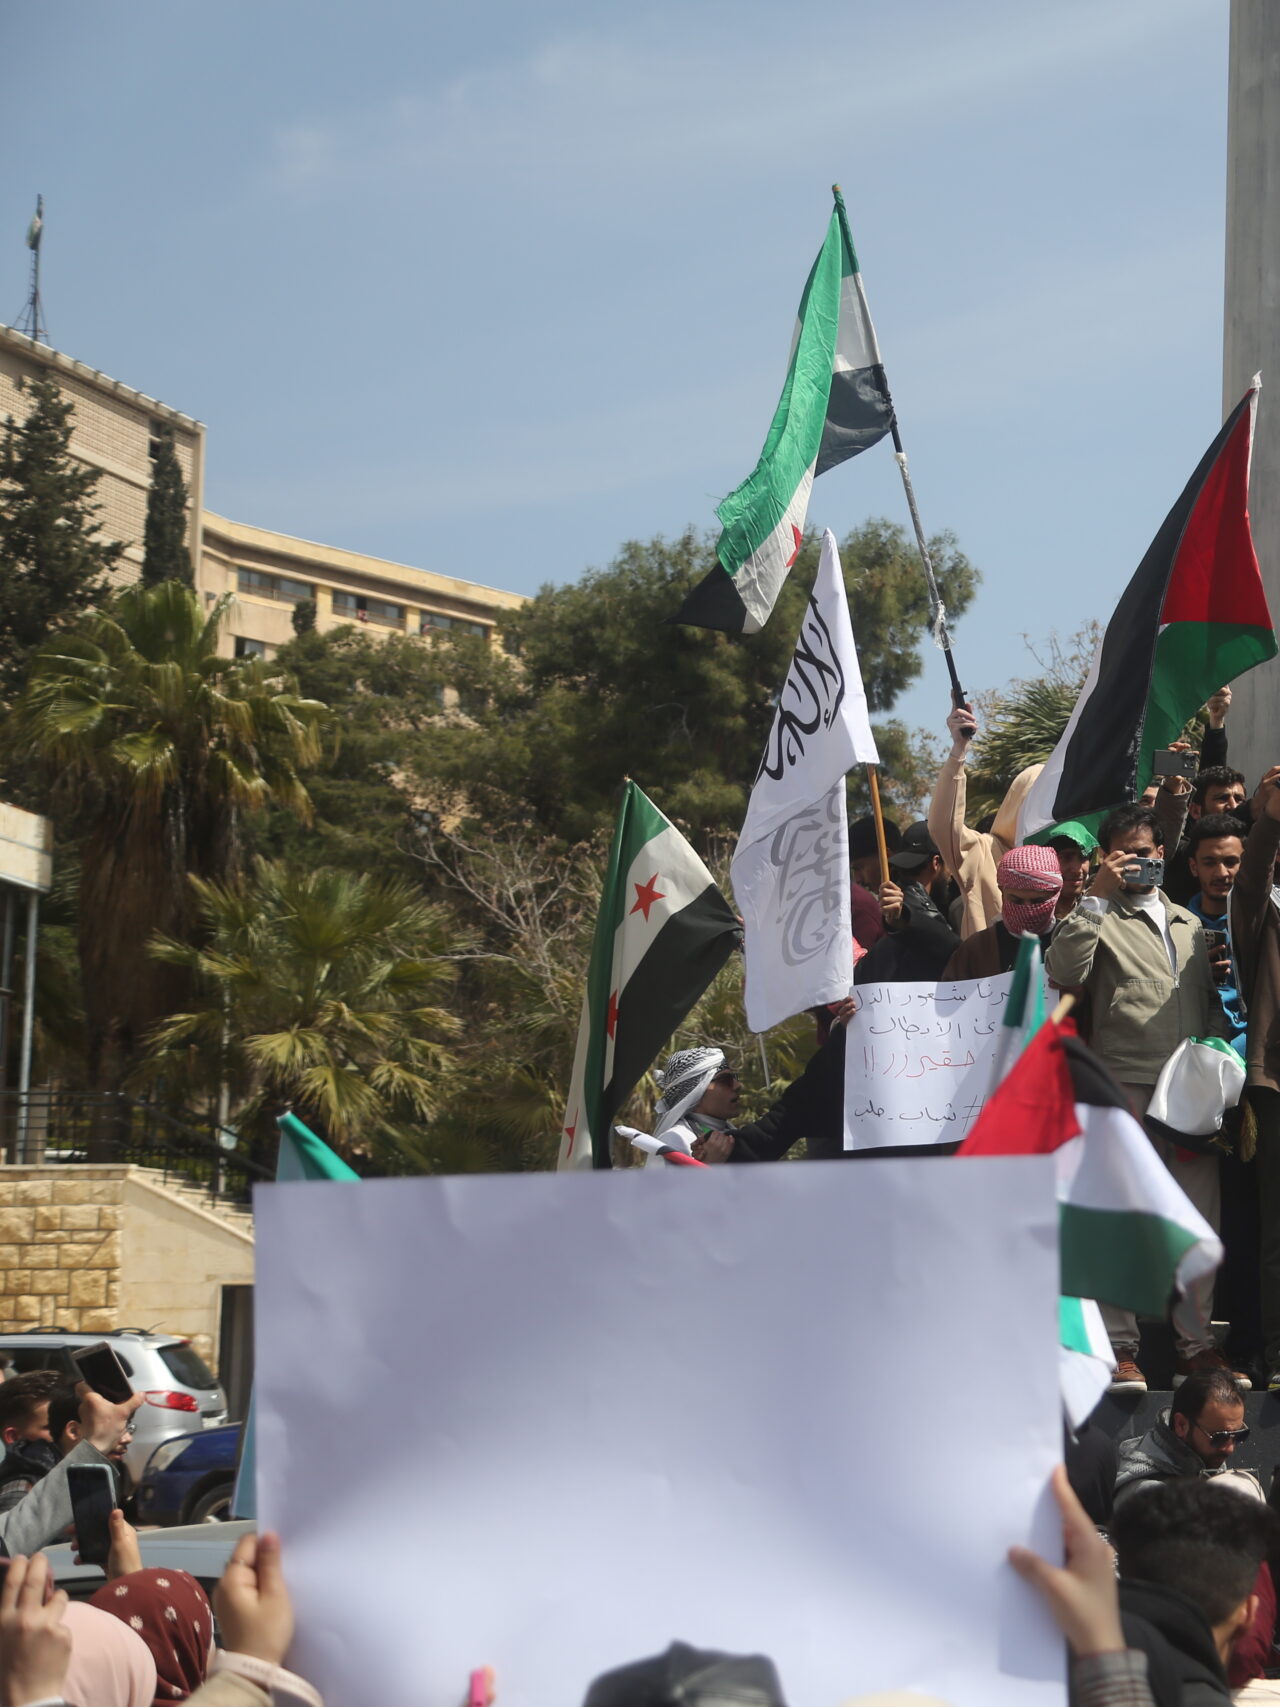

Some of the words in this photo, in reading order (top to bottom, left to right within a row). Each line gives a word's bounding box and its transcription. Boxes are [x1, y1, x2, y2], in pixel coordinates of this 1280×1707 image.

[855, 986, 891, 1012] الذل
[901, 985, 968, 1007] شعور
[869, 1015, 962, 1040] الأبطال
